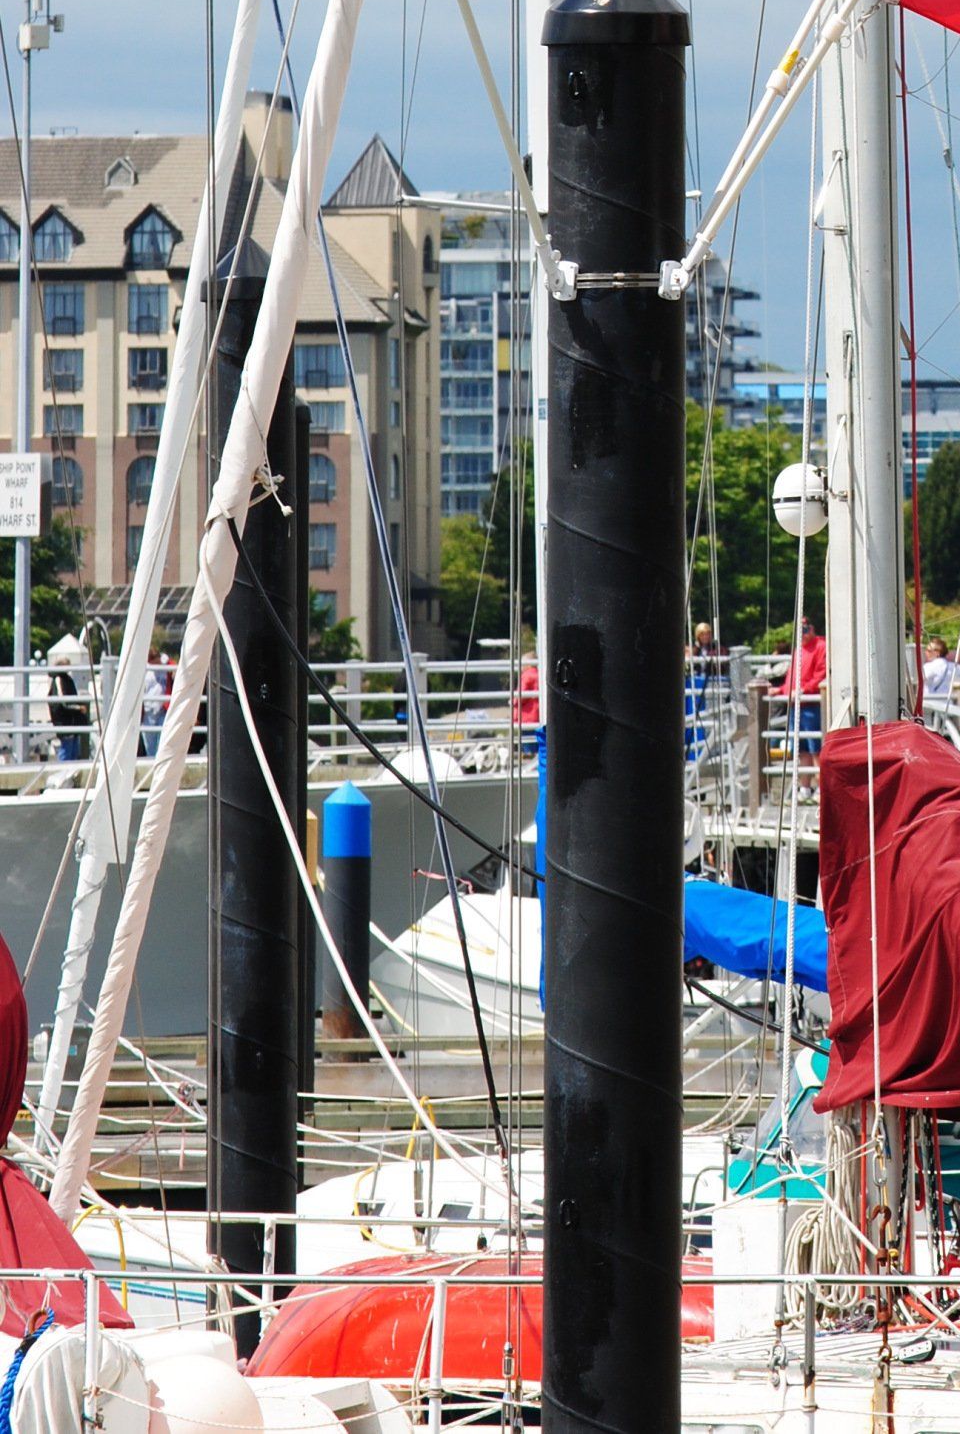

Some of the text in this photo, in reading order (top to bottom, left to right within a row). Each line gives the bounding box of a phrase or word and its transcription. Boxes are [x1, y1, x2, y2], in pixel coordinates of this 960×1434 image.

[16, 461, 35, 474] POINT
[5, 477, 28, 488] WHARF
[9, 496, 23, 509] 814
